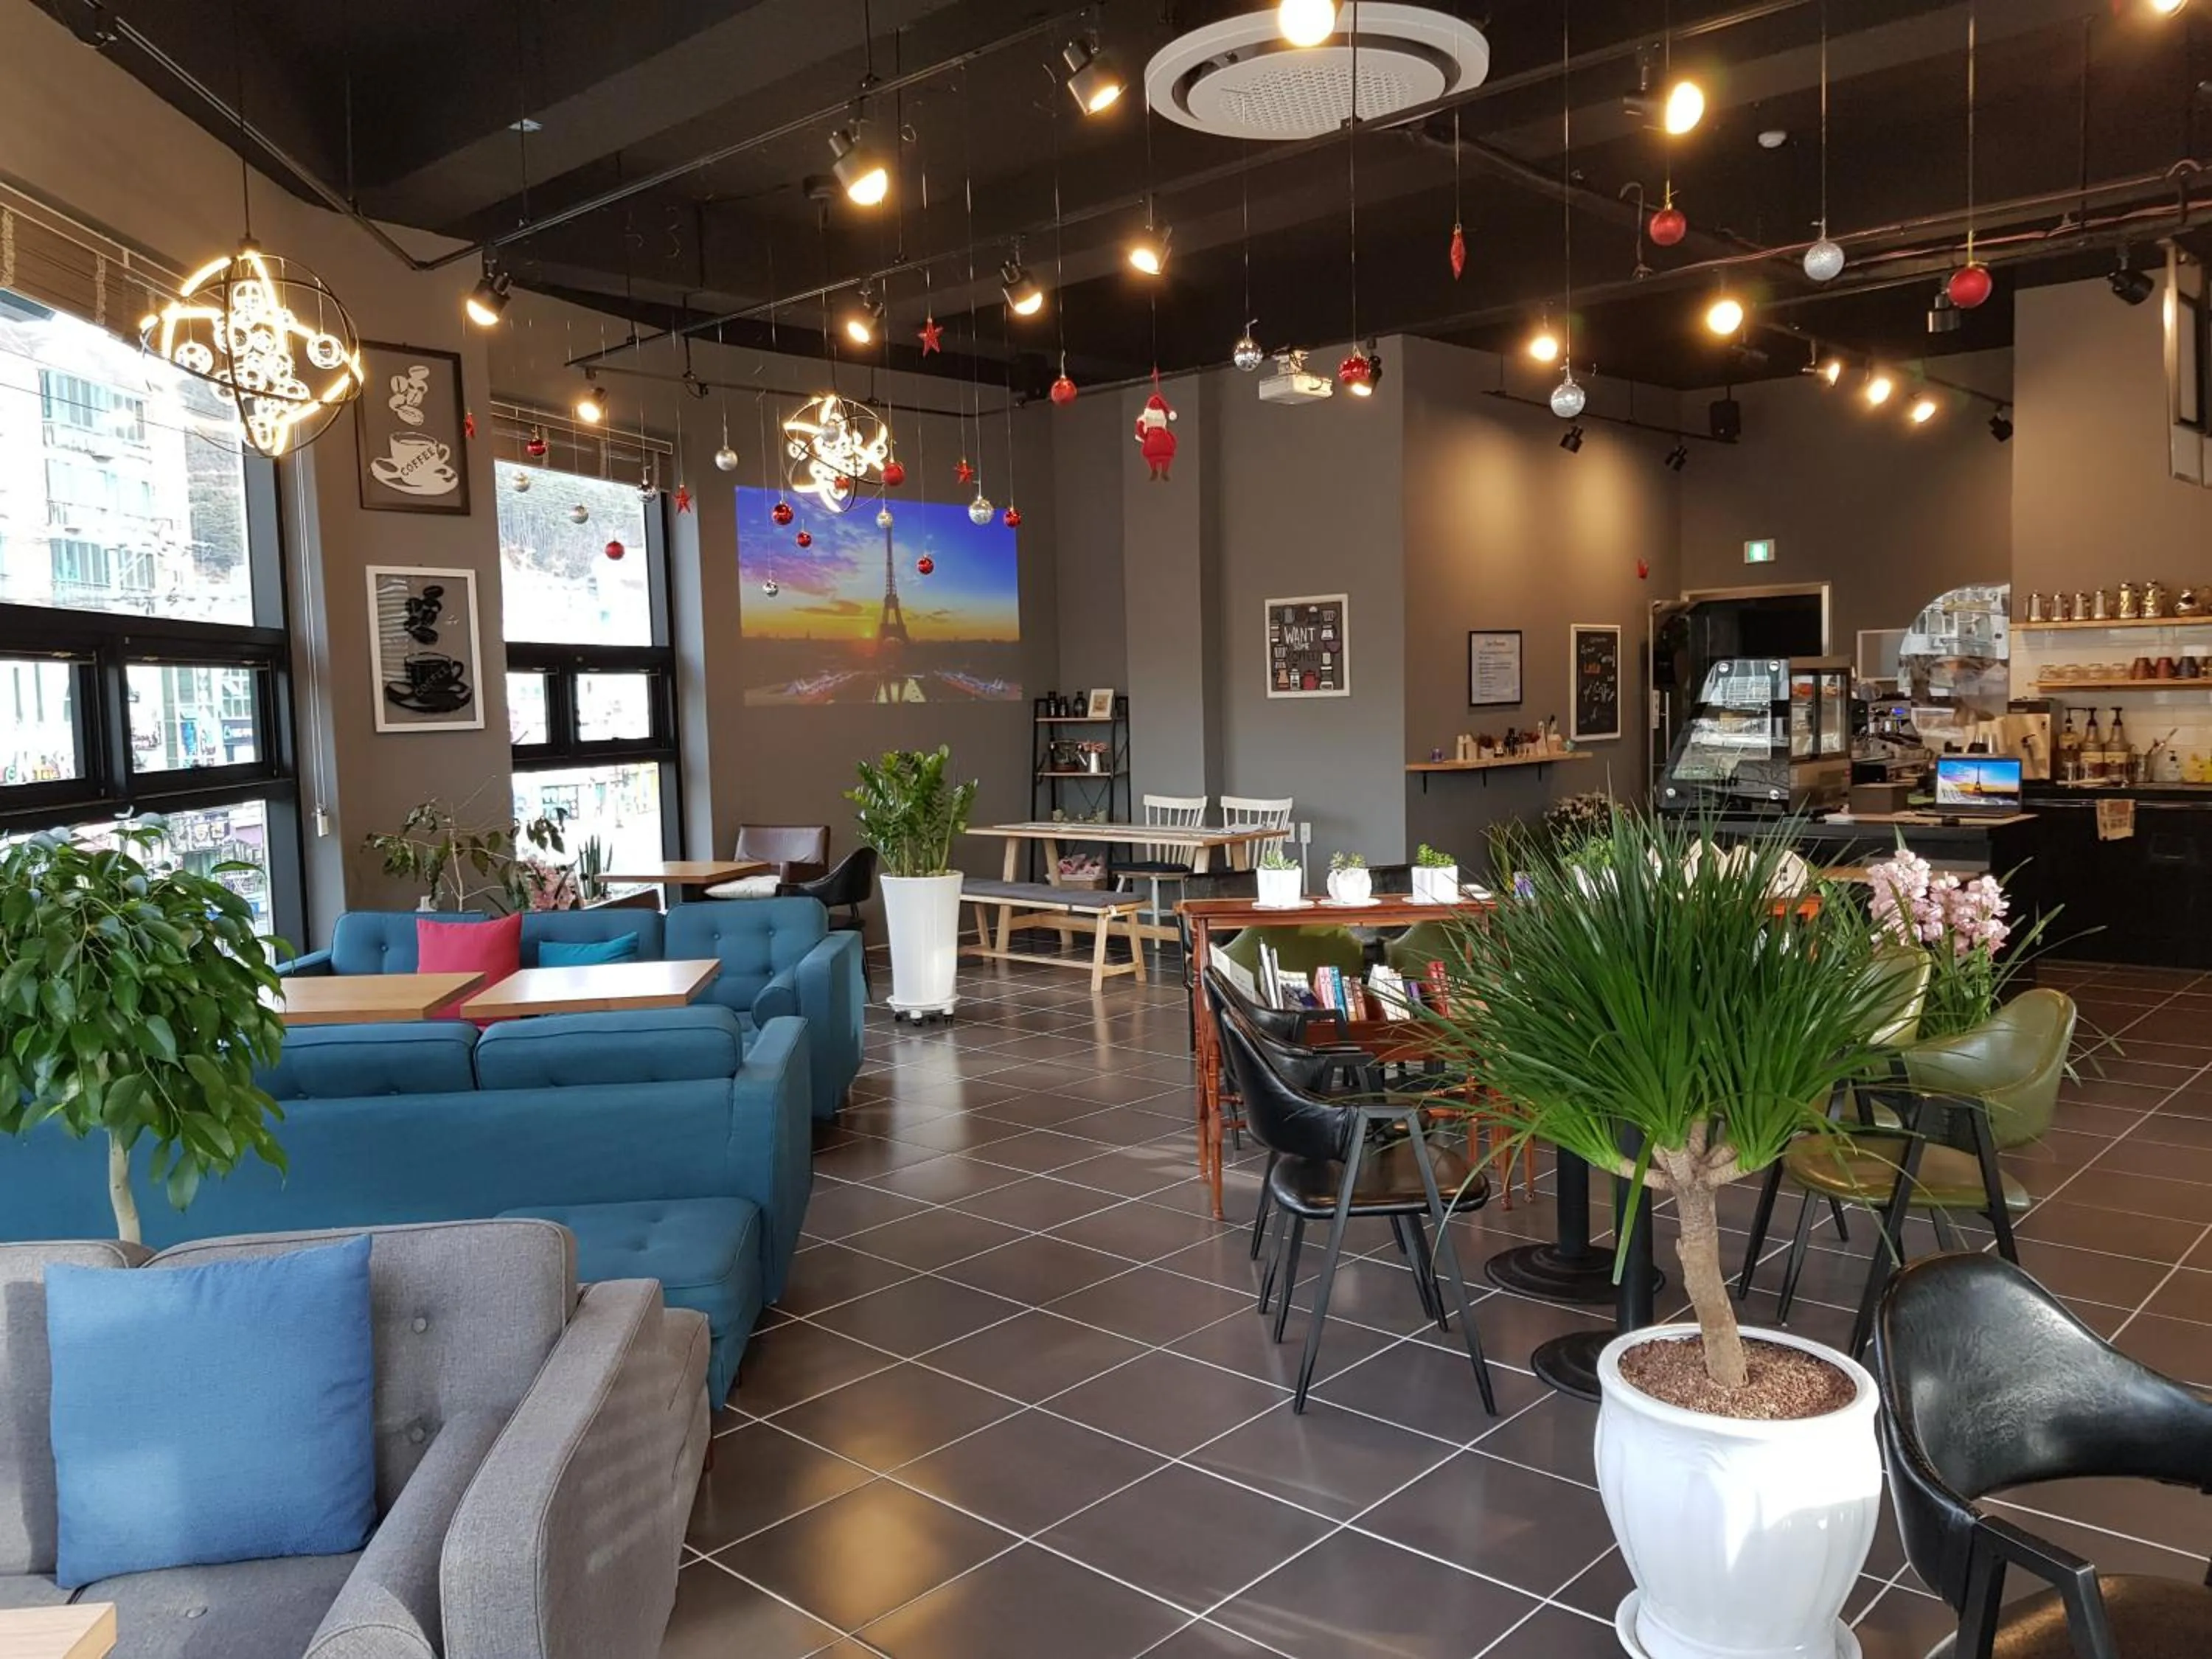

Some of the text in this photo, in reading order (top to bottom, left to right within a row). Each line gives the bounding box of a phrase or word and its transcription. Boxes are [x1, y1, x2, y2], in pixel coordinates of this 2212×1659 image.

[400, 447, 436, 476] COFFEE
[1284, 626, 1315, 644] WANT
[416, 667, 450, 697] COFFEE
